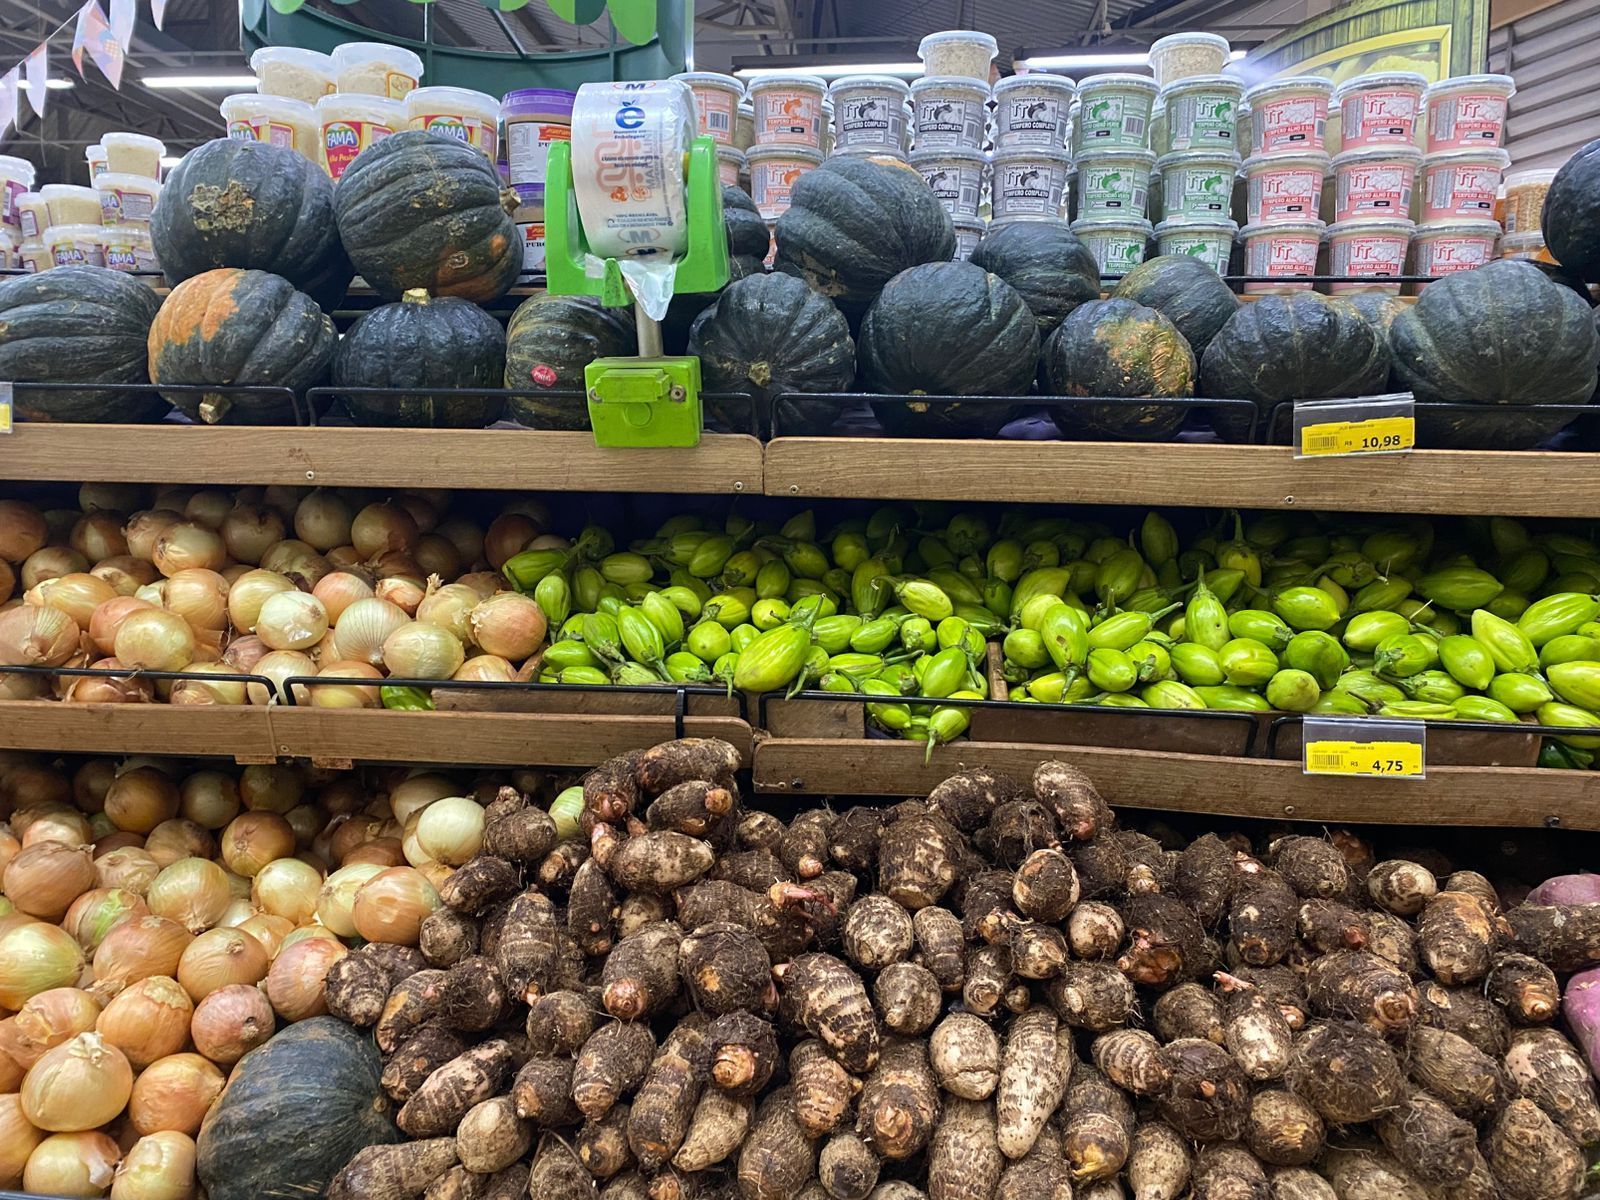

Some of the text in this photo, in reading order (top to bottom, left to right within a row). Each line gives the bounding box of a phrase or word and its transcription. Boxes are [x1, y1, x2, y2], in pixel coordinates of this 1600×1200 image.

[1265, 101, 1290, 109] Tempero
[1366, 99, 1386, 115] TT
[1460, 102, 1480, 118] TT
[1265, 110, 1283, 124] TT
[327, 130, 354, 147] FAMA
[1264, 179, 1283, 193] TT
[1351, 174, 1370, 188] TT
[1457, 173, 1477, 188] TT
[55, 251, 81, 265] FAMA
[108, 252, 134, 265] FAMA
[1273, 245, 1292, 260] TT
[1351, 244, 1372, 259] TT
[1435, 245, 1455, 261] TT
[1362, 435, 1401, 449] 10,98
[1372, 760, 1403, 773] 4,75
